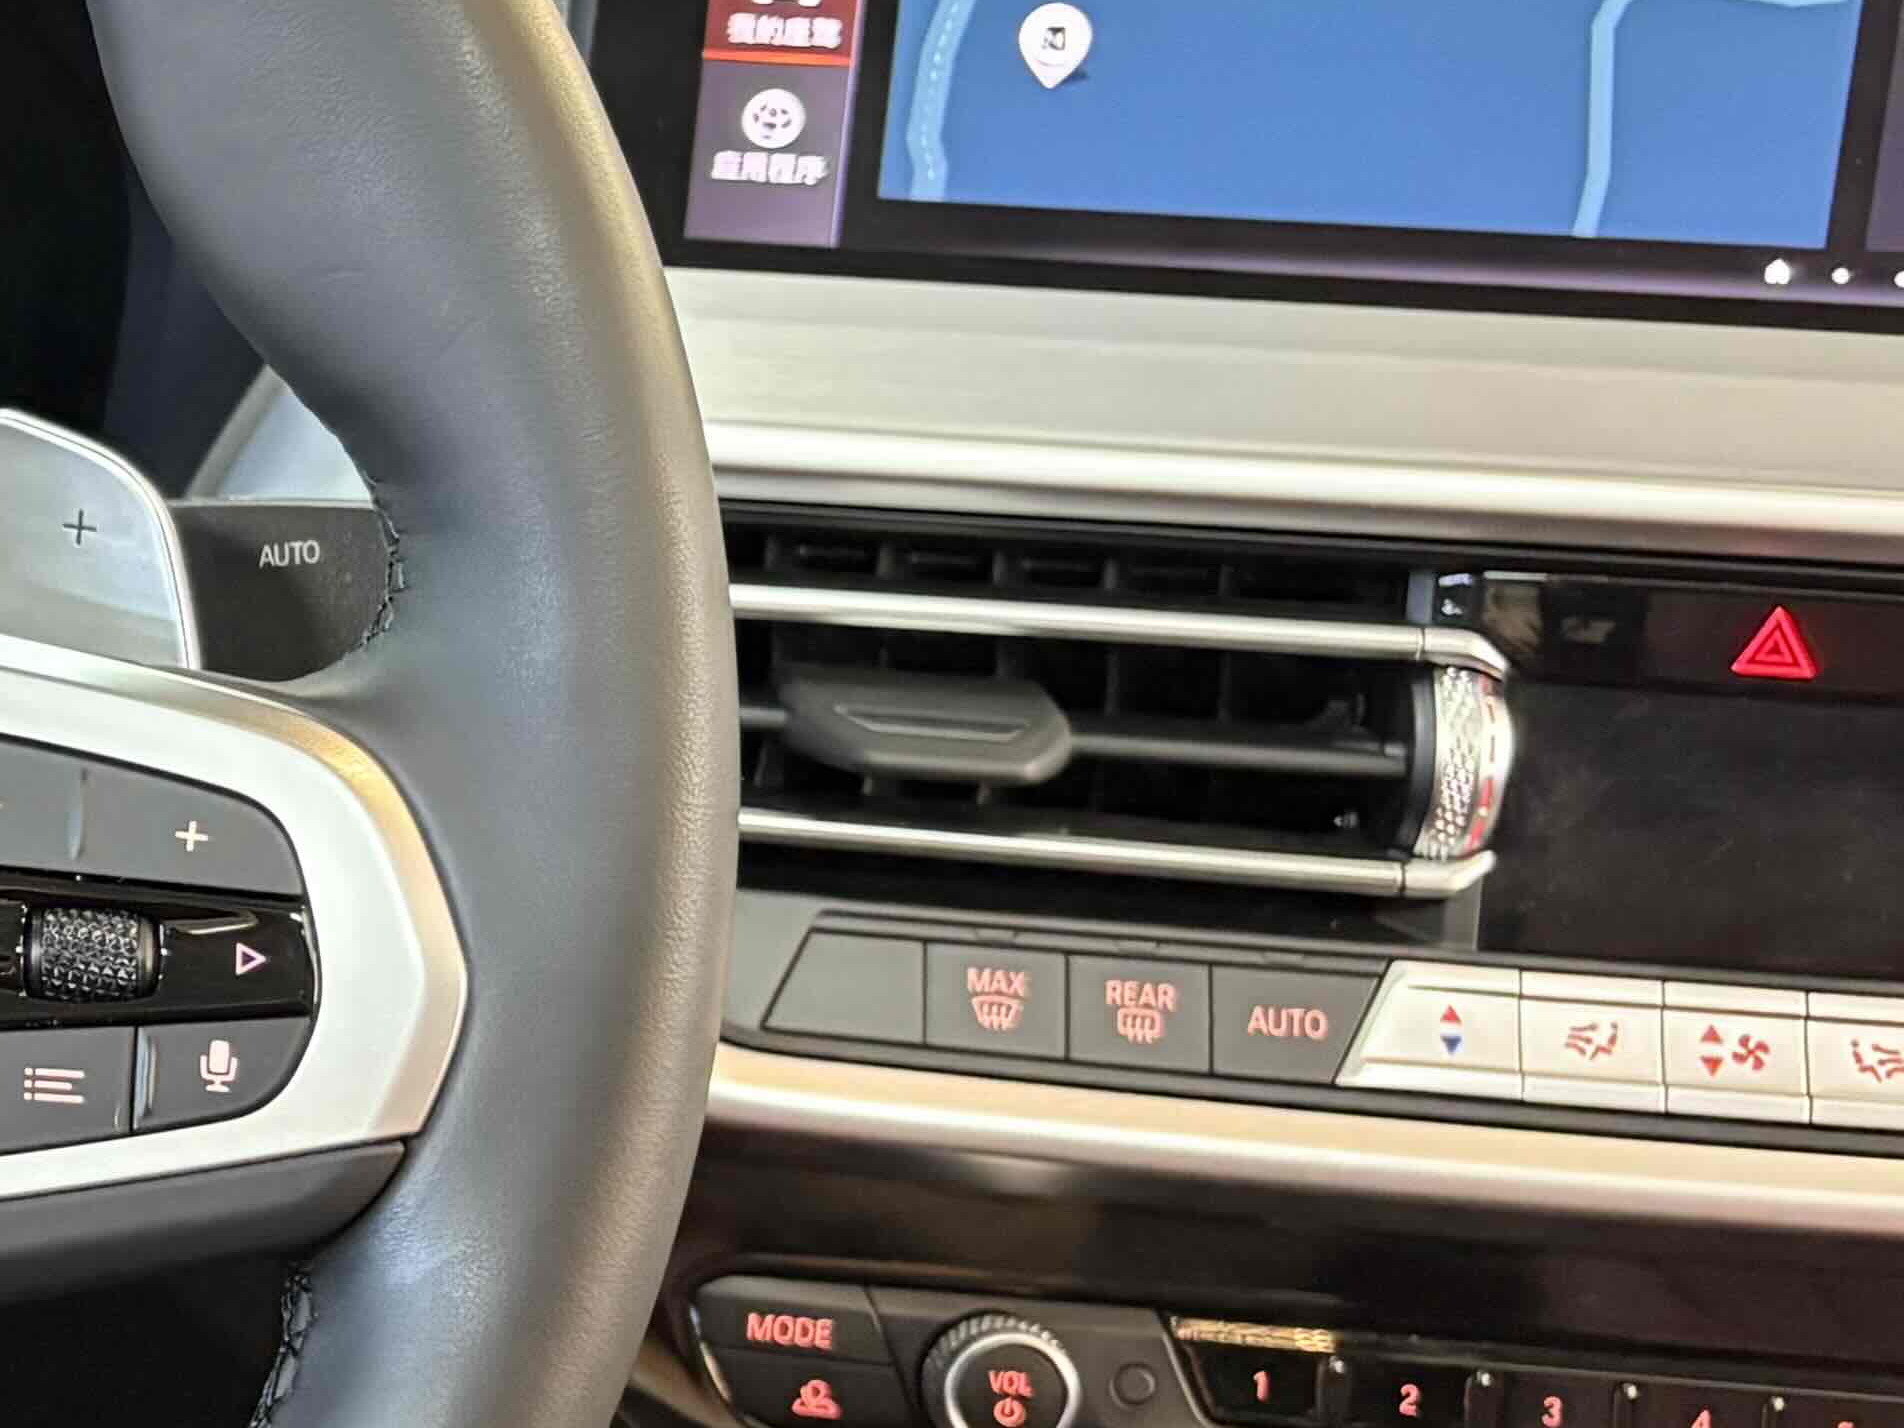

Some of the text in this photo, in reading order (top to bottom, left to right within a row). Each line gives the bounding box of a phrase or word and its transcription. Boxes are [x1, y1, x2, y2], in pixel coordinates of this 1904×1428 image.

[258, 539, 321, 568] AUTO
[965, 966, 1027, 999] MAX
[1105, 978, 1176, 1012] REAR
[1246, 1004, 1328, 1040] AUTO
[745, 1311, 834, 1350] MODE
[987, 1370, 1032, 1398] VOL
[1252, 1372, 1269, 1402] 1
[1398, 1385, 1422, 1417] 2
[1541, 1396, 1564, 1428] 3
